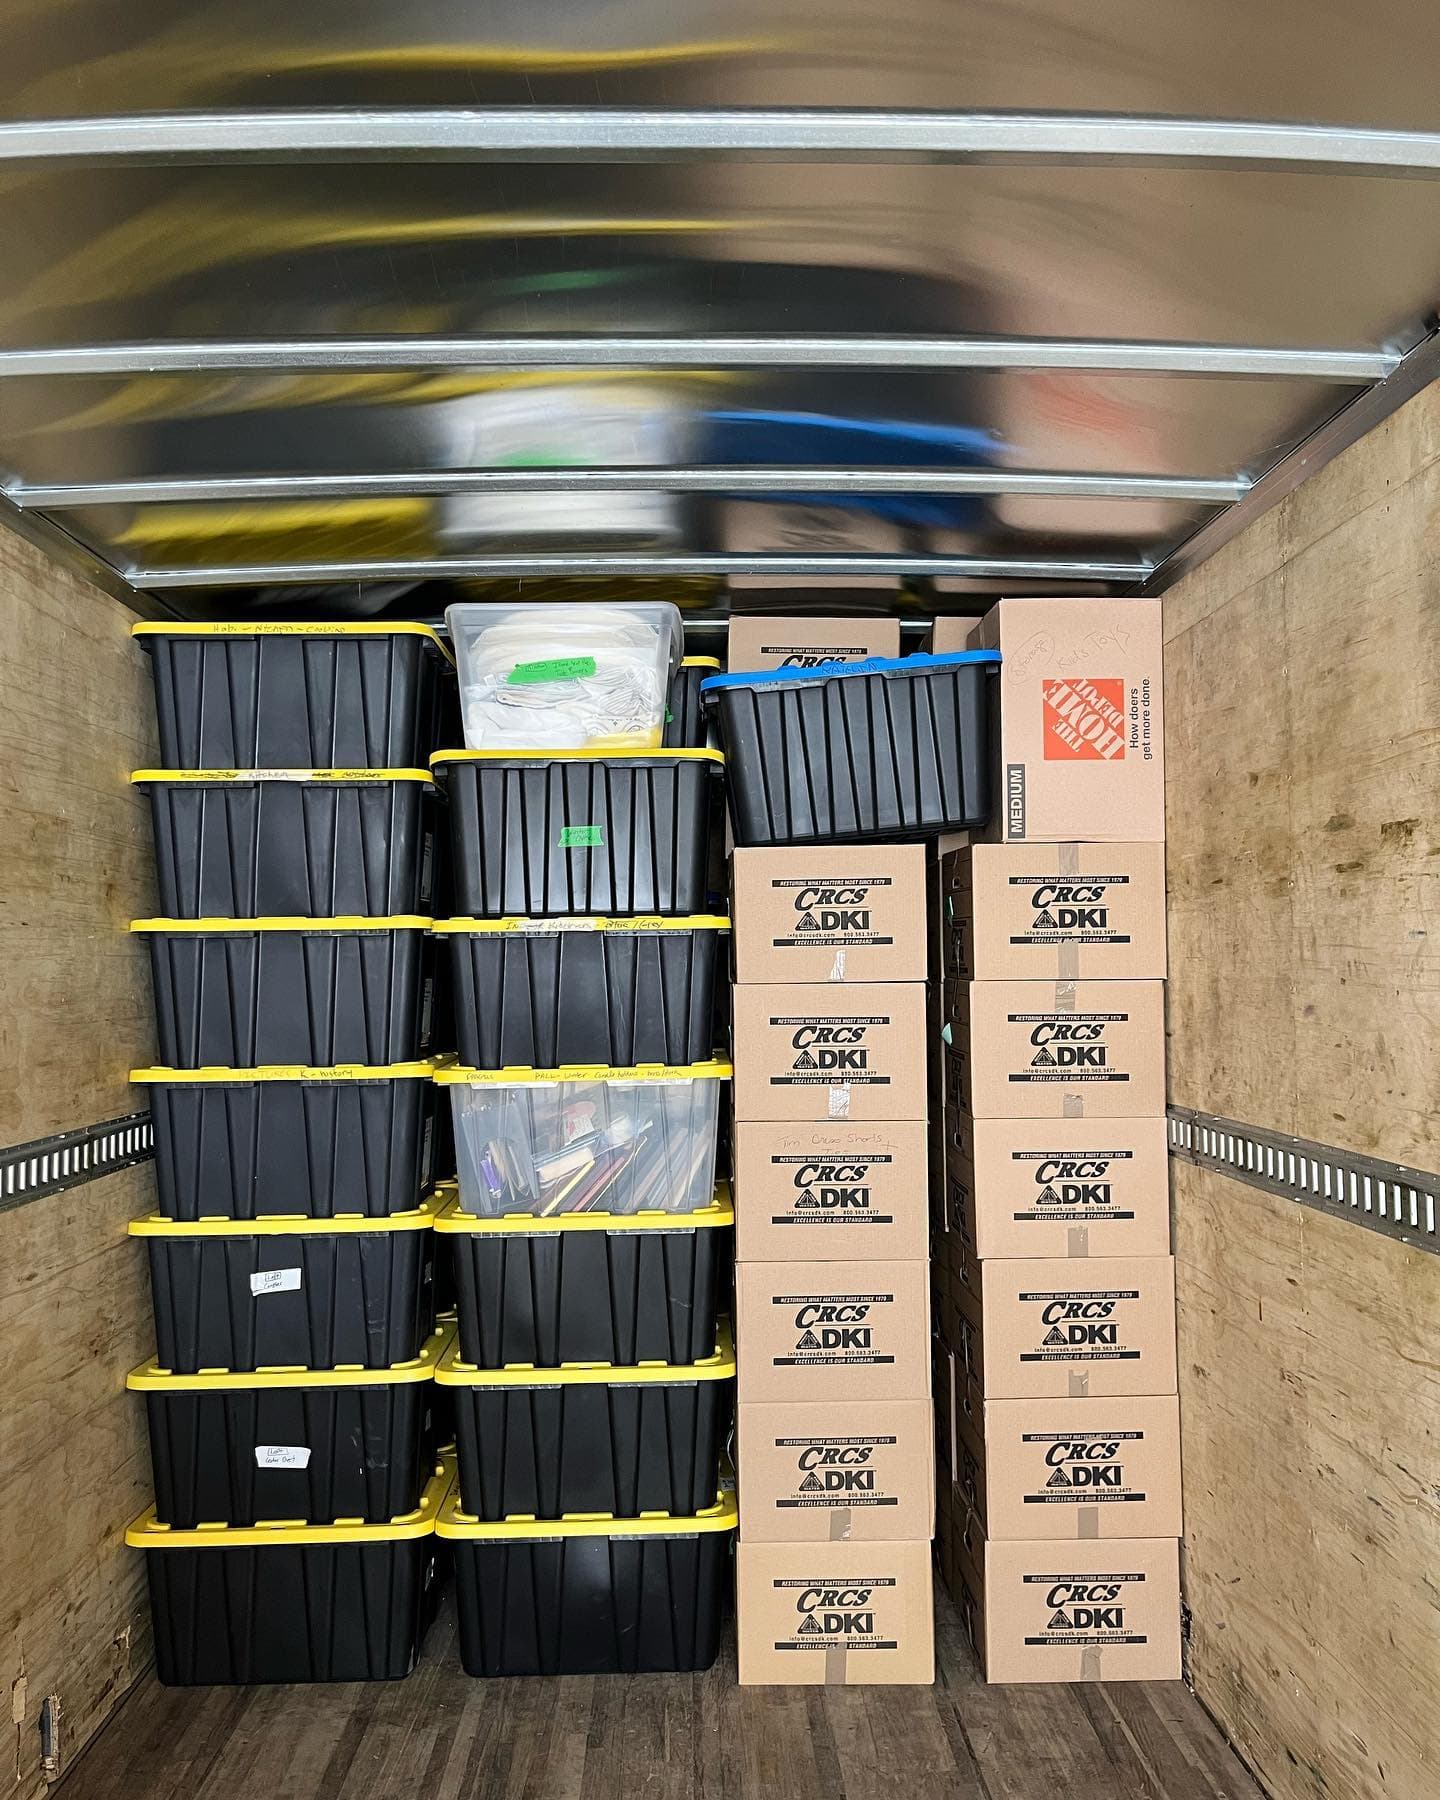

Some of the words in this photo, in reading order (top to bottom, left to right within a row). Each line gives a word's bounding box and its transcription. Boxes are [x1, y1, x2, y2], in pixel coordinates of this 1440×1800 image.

[1141, 676, 1151, 707] done.
[1073, 679, 1124, 729] DEPOT
[1129, 688, 1139, 720] doers
[1042, 679, 1125, 760] HOME
[1142, 710, 1151, 739] more
[1052, 719, 1084, 753] THE
[1129, 723, 1139, 748] How
[1142, 742, 1153, 760] get
[1011, 769, 1023, 833] MEDIUM
[794, 887, 869, 911] CRCS
[1032, 885, 1106, 908] CRCS
[821, 911, 869, 930] DKI
[1058, 909, 1107, 928] DKI
[792, 1026, 866, 1049] CRCS
[1030, 1023, 1105, 1046] CRCS
[819, 1050, 867, 1069] DKI
[1057, 1047, 1106, 1066] DKI
[794, 1164, 868, 1188] CRCS
[1035, 1160, 1110, 1184] CRCS
[821, 1189, 869, 1208] DKI
[1062, 1185, 1111, 1204] DKI
[795, 1304, 870, 1329] CRCS
[1042, 1300, 1116, 1325] CRCS
[822, 1329, 871, 1349] DKI
[1069, 1325, 1117, 1345] DKI
[798, 1446, 873, 1471] CRCS
[1045, 1442, 1120, 1466] CRCS
[825, 1471, 874, 1491] DKI
[1072, 1466, 1121, 1486] DKI
[796, 1588, 872, 1613] CRCS
[1046, 1583, 1122, 1608] CRCS
[824, 1613, 873, 1634] DKI
[1074, 1608, 1123, 1629] DKI
